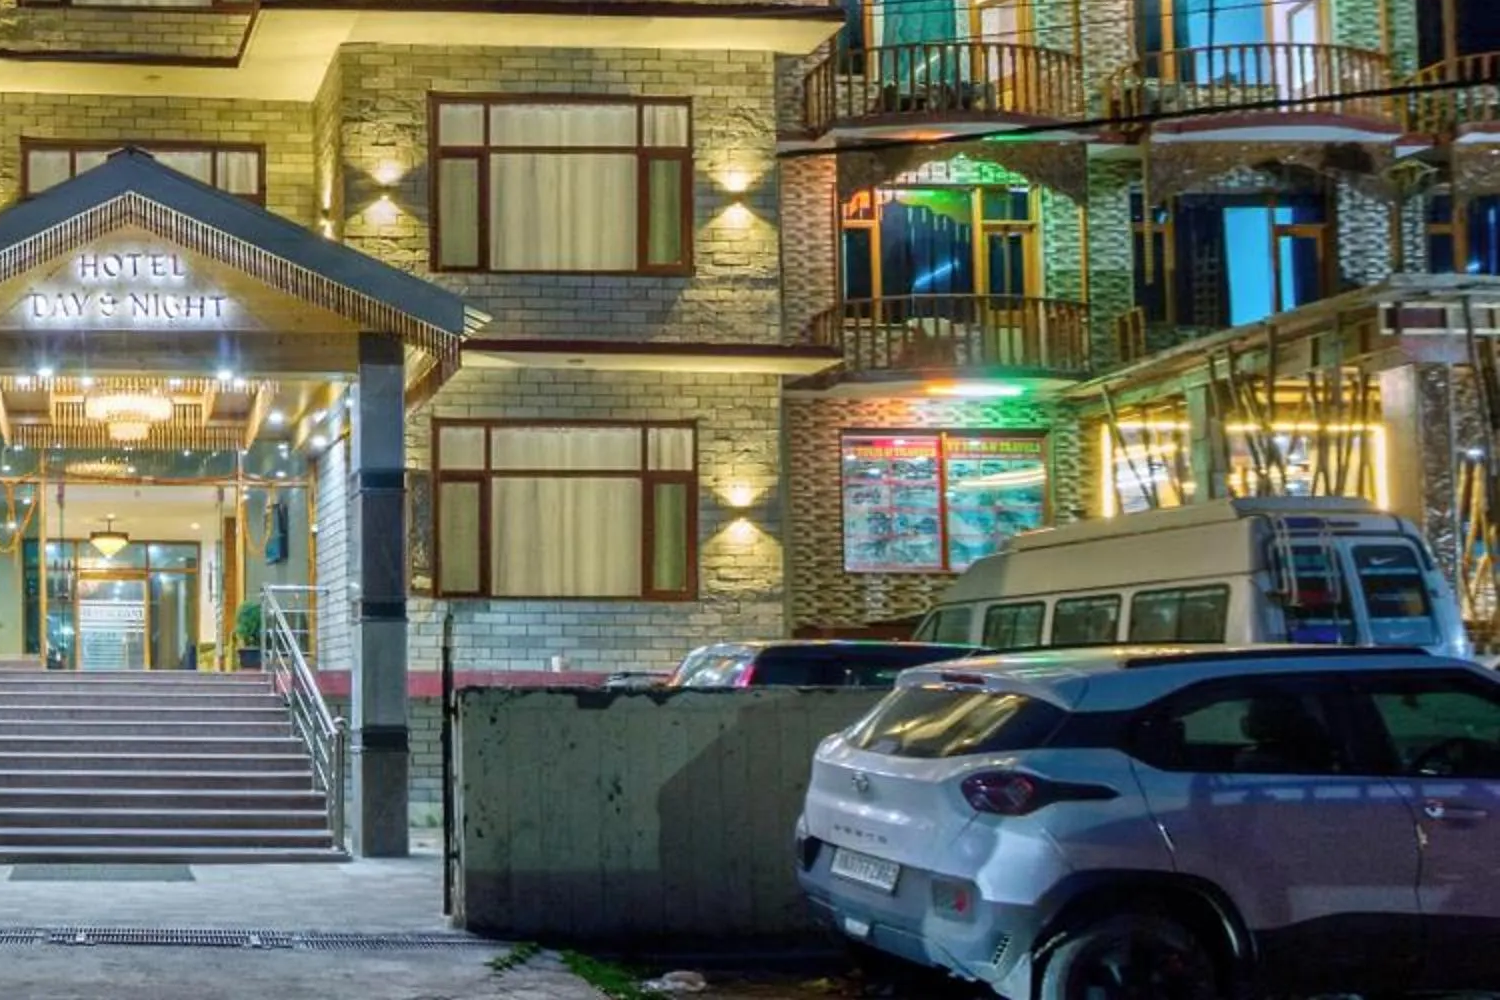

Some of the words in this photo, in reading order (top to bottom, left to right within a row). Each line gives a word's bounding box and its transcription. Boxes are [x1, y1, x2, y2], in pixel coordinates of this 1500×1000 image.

[79, 252, 186, 278] HOTEL
[29, 292, 91, 317] DAY
[129, 292, 227, 319] NIGHT
